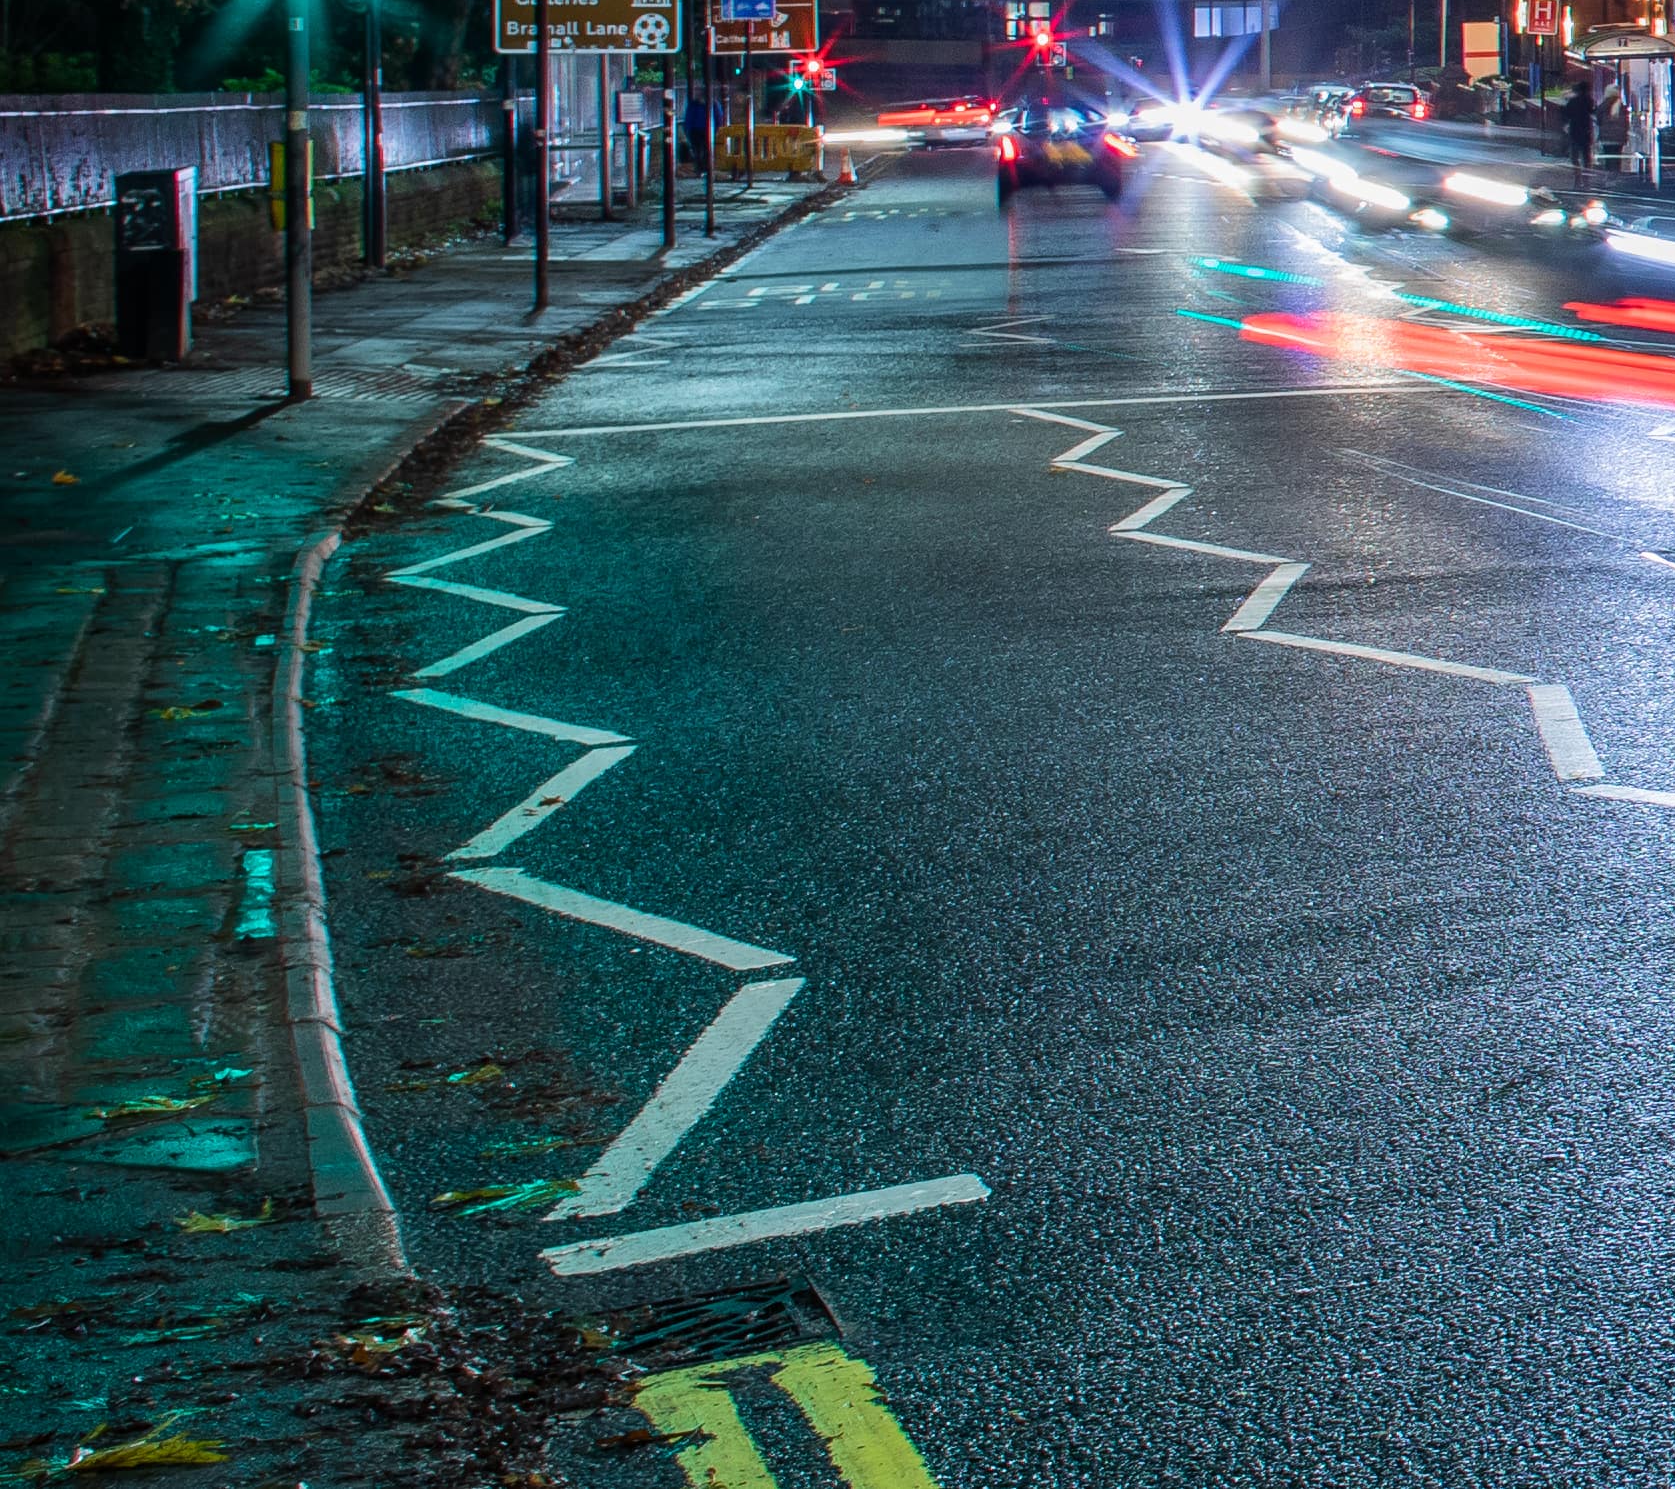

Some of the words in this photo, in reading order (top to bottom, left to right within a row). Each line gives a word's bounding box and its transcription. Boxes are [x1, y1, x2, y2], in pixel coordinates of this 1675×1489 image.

[1535, 0, 1552, 20] H
[507, 21, 580, 36] Braall
[586, 22, 629, 36] Lane
[716, 34, 768, 44] Catheral
